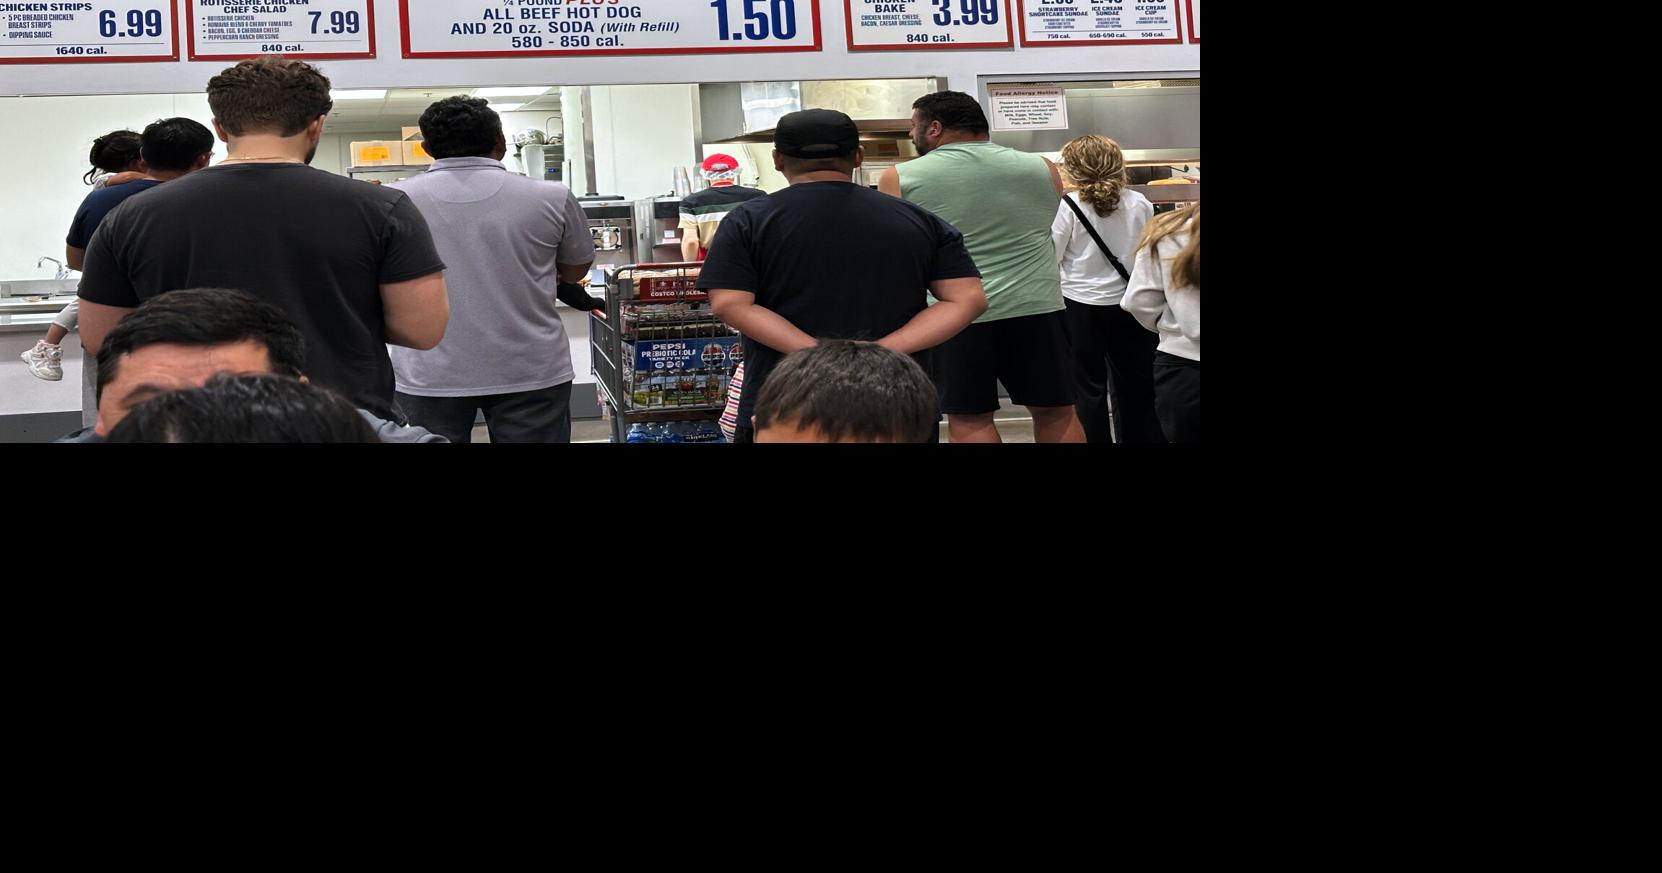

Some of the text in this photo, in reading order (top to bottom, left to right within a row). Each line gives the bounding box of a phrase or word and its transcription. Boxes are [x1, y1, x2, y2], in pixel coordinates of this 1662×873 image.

[483, 6, 641, 20] ALL BEEF HOT DOG
[875, 4, 906, 13] BAKE
[932, 0, 998, 27] 3.99
[99, 9, 162, 37] 6.99
[308, 11, 360, 34] 7.99
[710, 0, 796, 41] 1.50
[450, 21, 679, 35] AND 20 oz. SODA (With Refill)
[512, 36, 542, 48] 580
[560, 36, 590, 47] 850
[596, 35, 624, 47] cal.
[907, 33, 954, 42] 840 cal.
